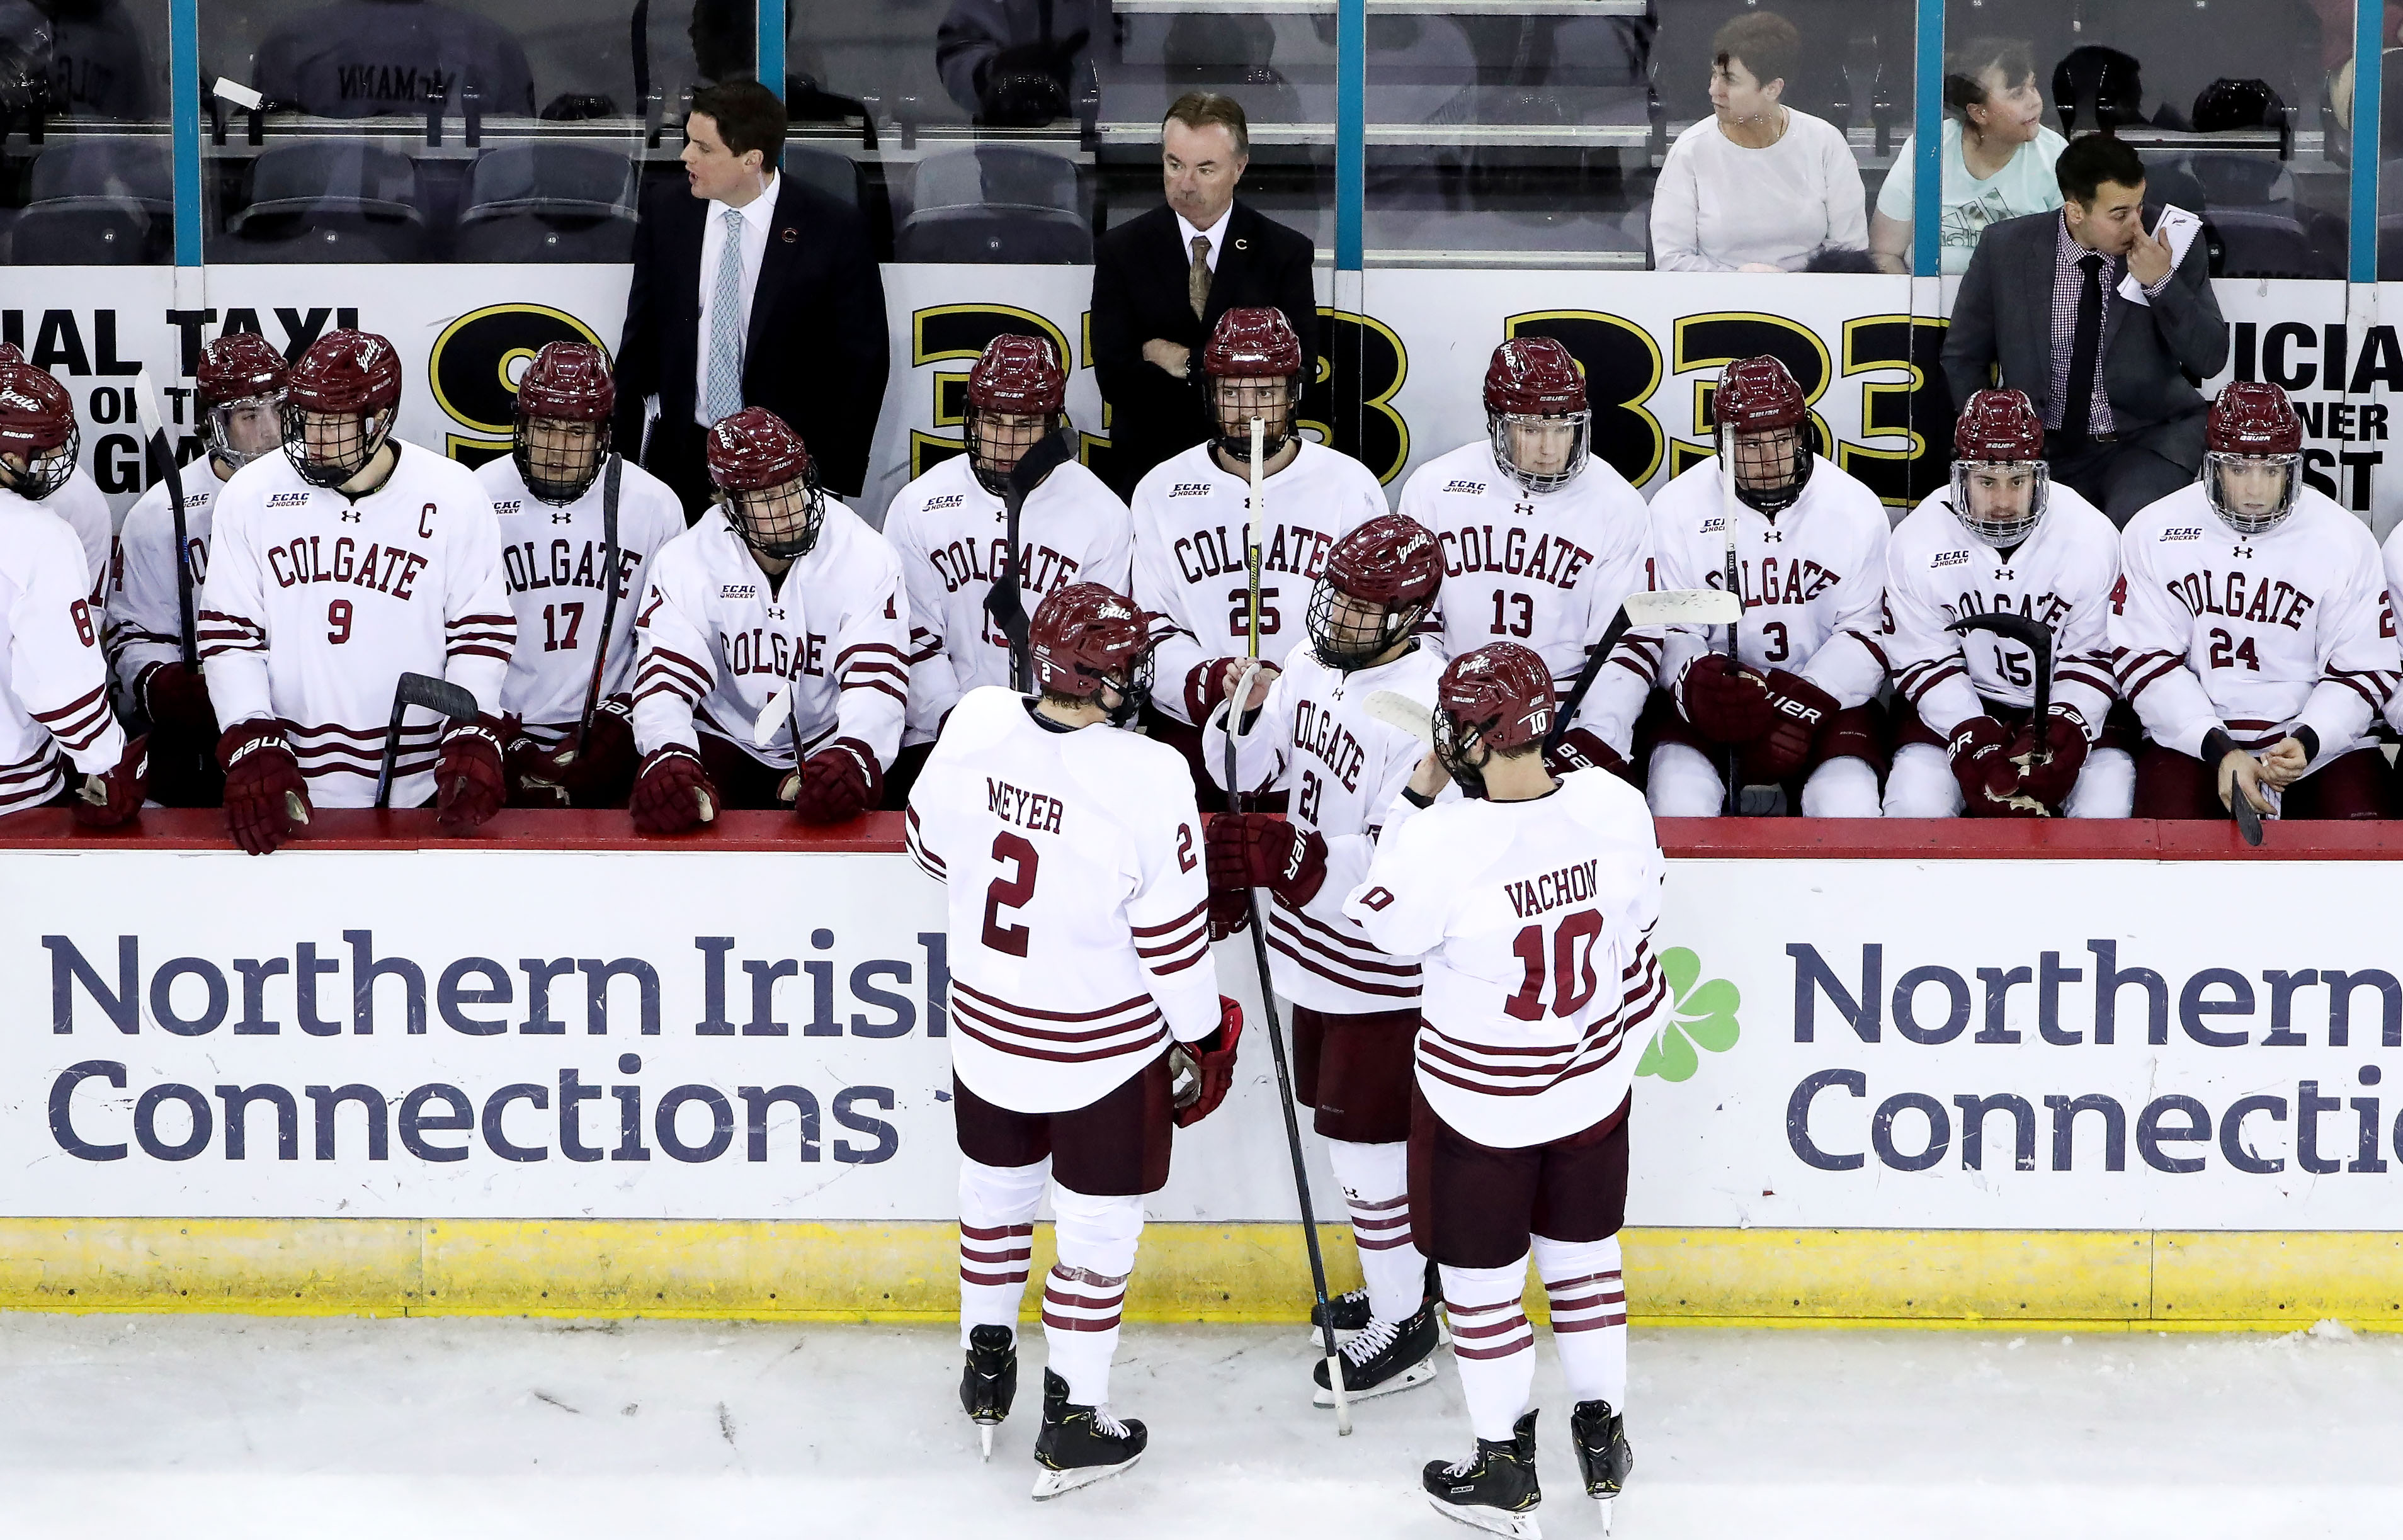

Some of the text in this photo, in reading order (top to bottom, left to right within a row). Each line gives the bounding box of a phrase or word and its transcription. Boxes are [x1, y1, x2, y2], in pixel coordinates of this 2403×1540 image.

[272, 493, 310, 502] ECAC
[927, 495, 964, 506] ECAC
[931, 502, 962, 511] HOCKEY
[1448, 480, 1487, 490] ECAC
[1451, 487, 1482, 495] HOCKEY
[418, 503, 437, 538] C
[2164, 528, 2203, 536] ECAC
[268, 535, 429, 601] COLGATE
[1438, 525, 1594, 589] COLGATE
[1934, 550, 1970, 562] ECAC
[1401, 574, 1427, 587] BAUER
[70, 598, 95, 648] 8
[327, 599, 353, 645] 9
[543, 602, 584, 652] 17
[636, 584, 663, 629] 7
[1228, 587, 1281, 636] 25
[1490, 589, 1533, 638] 13
[1763, 621, 1790, 662] 3
[2209, 628, 2260, 672] 24
[1041, 662, 1052, 682] 2
[1993, 645, 2032, 687] 15
[1531, 712, 1547, 735] 10
[986, 777, 1064, 835] MEYER
[1298, 769, 1322, 827] 21
[1176, 822, 1198, 875] 2
[981, 830, 1039, 958] 2
[1504, 859, 1598, 918] VACHON
[42, 929, 661, 1036] Northern
[1504, 908, 1605, 1021] 10
[1786, 939, 2403, 1047] Northern
[48, 1053, 899, 1164] Connections
[1786, 1064, 2403, 1174] Connecti
